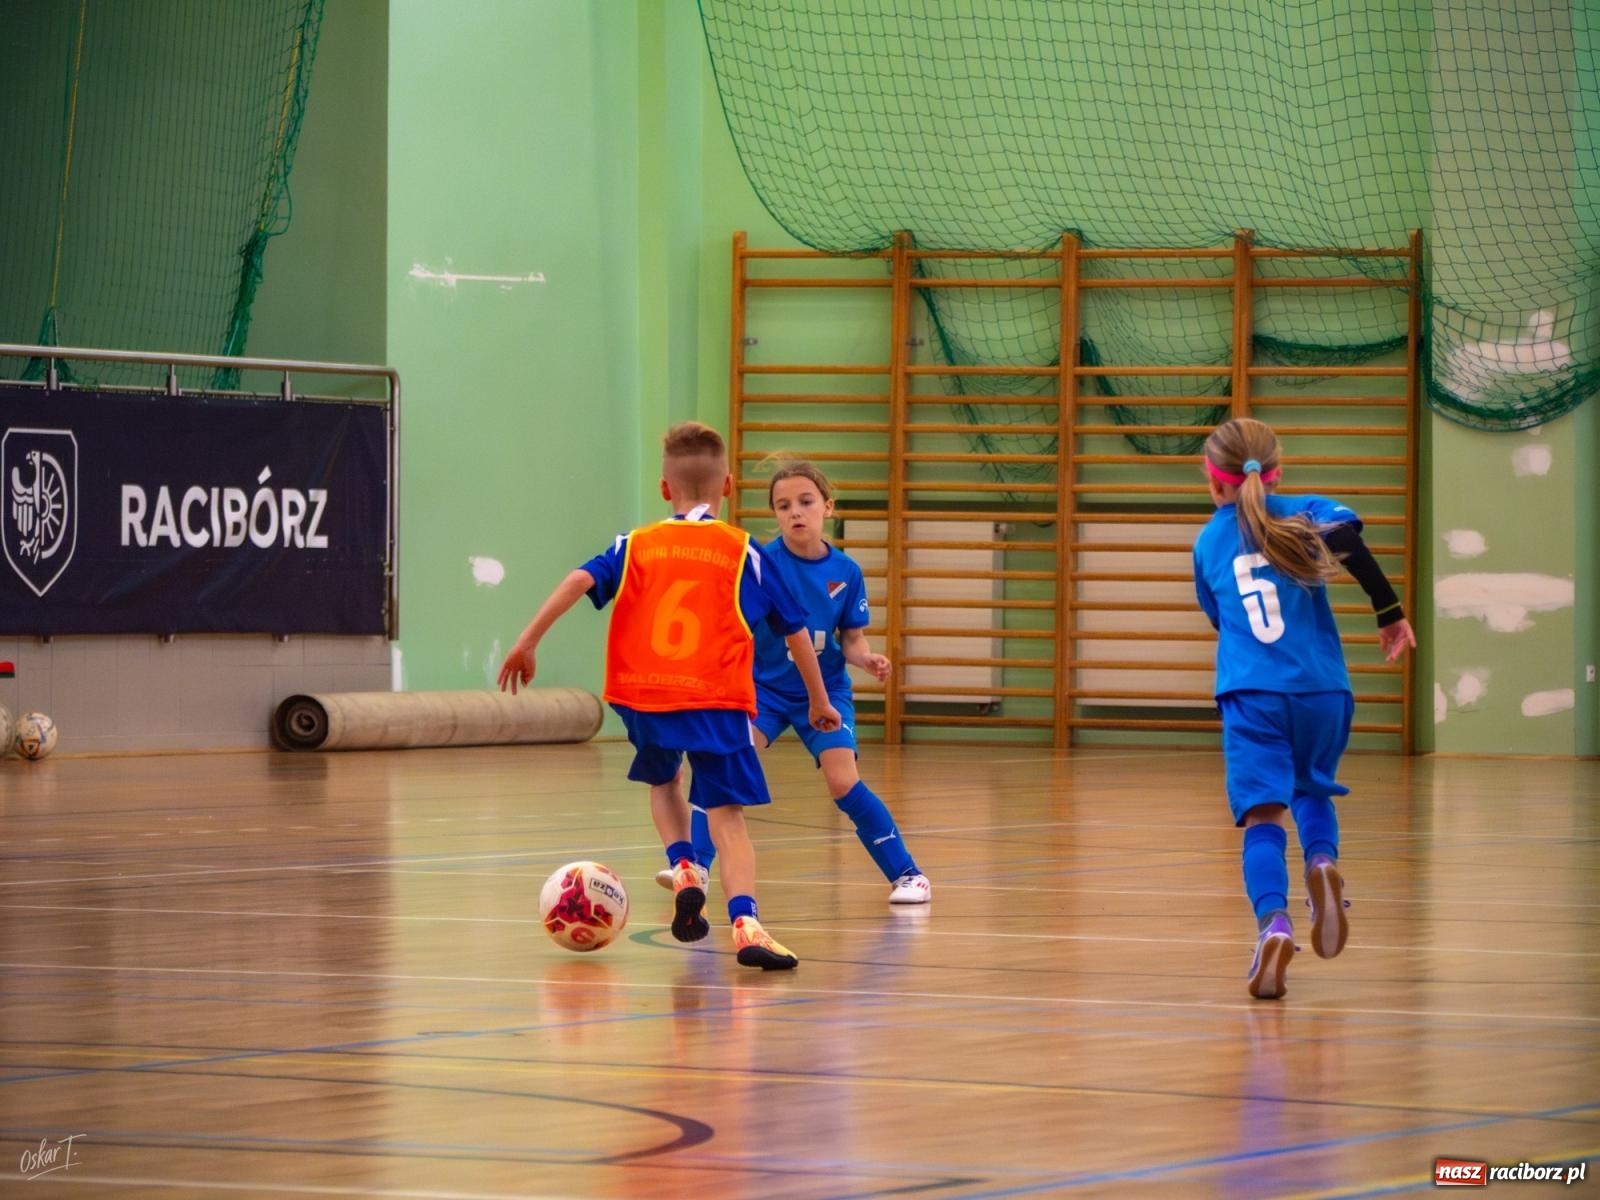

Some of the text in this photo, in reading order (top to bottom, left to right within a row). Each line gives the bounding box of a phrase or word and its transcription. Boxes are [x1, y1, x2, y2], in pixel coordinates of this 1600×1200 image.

[121, 465, 329, 549] RACIBÓRZ
[651, 579, 700, 661] 6
[1233, 552, 1285, 644] 5
